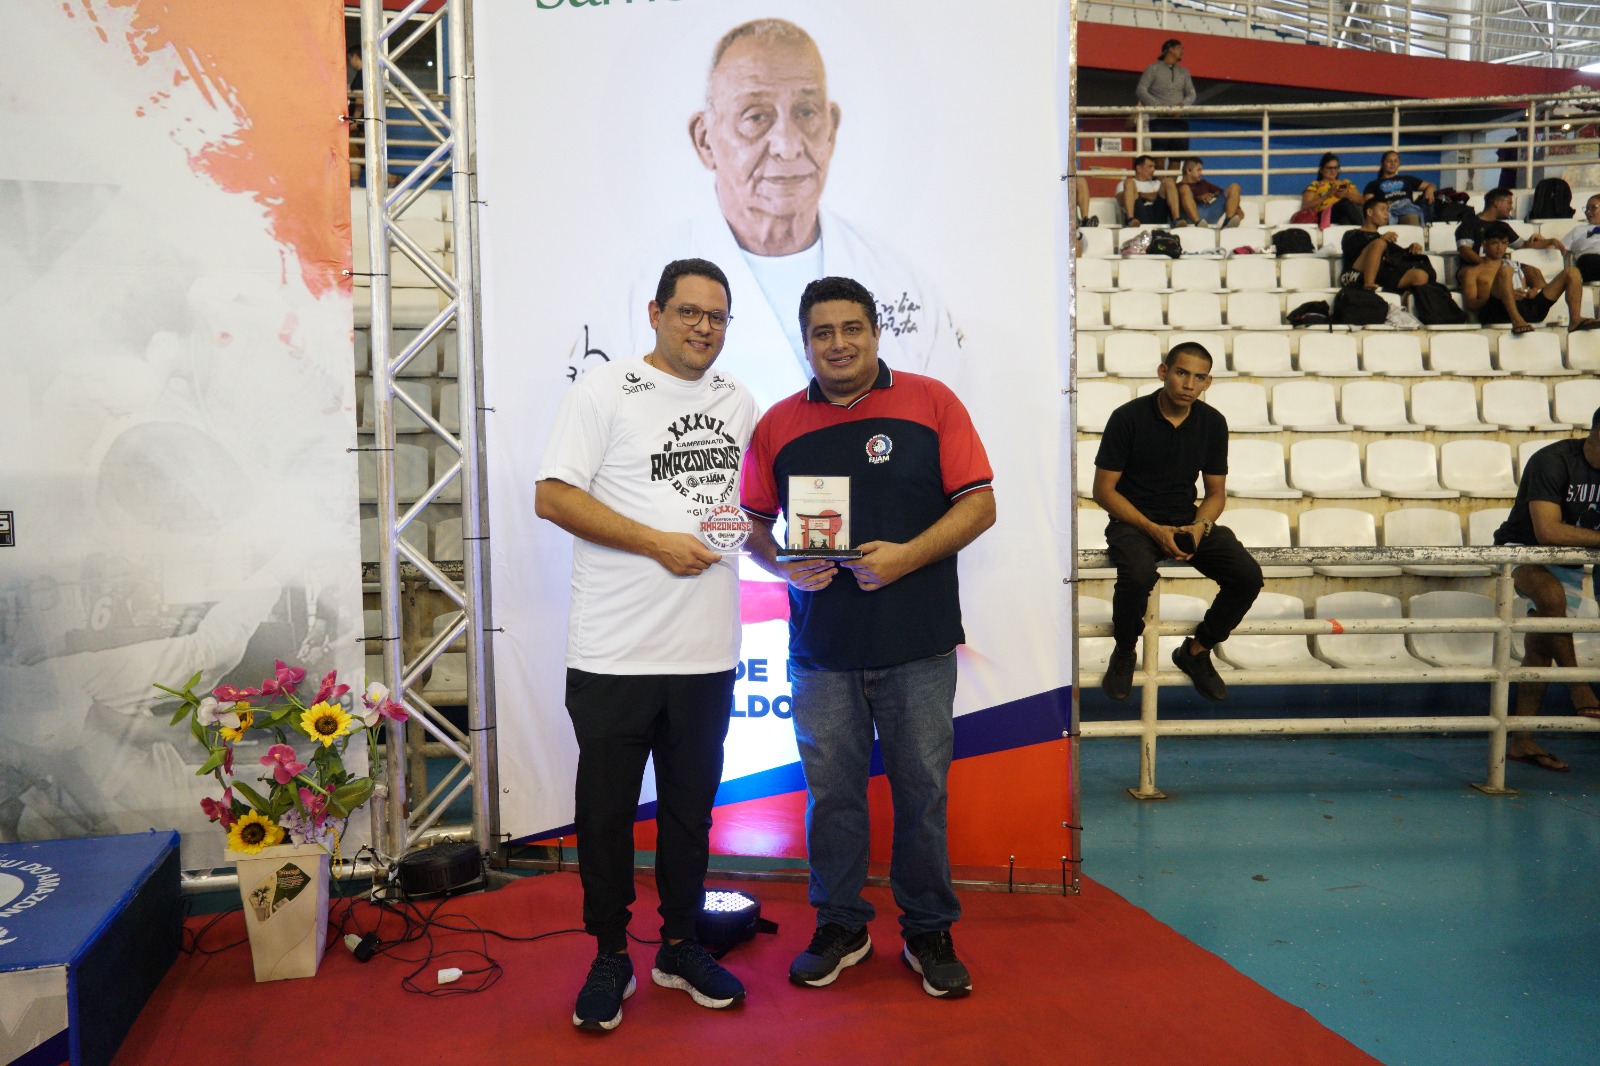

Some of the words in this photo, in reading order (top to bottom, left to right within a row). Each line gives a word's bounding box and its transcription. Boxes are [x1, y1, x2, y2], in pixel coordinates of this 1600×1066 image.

[668, 413, 725, 442] XXXVI
[676, 438, 724, 448] CAMPEONATO
[651, 446, 740, 481] AMAZONENSE
[671, 479, 690, 498] DE
[692, 478, 734, 504] JIU-JITSU
[712, 505, 740, 516] XXXVI
[700, 522, 751, 531] AMAZONENSE
